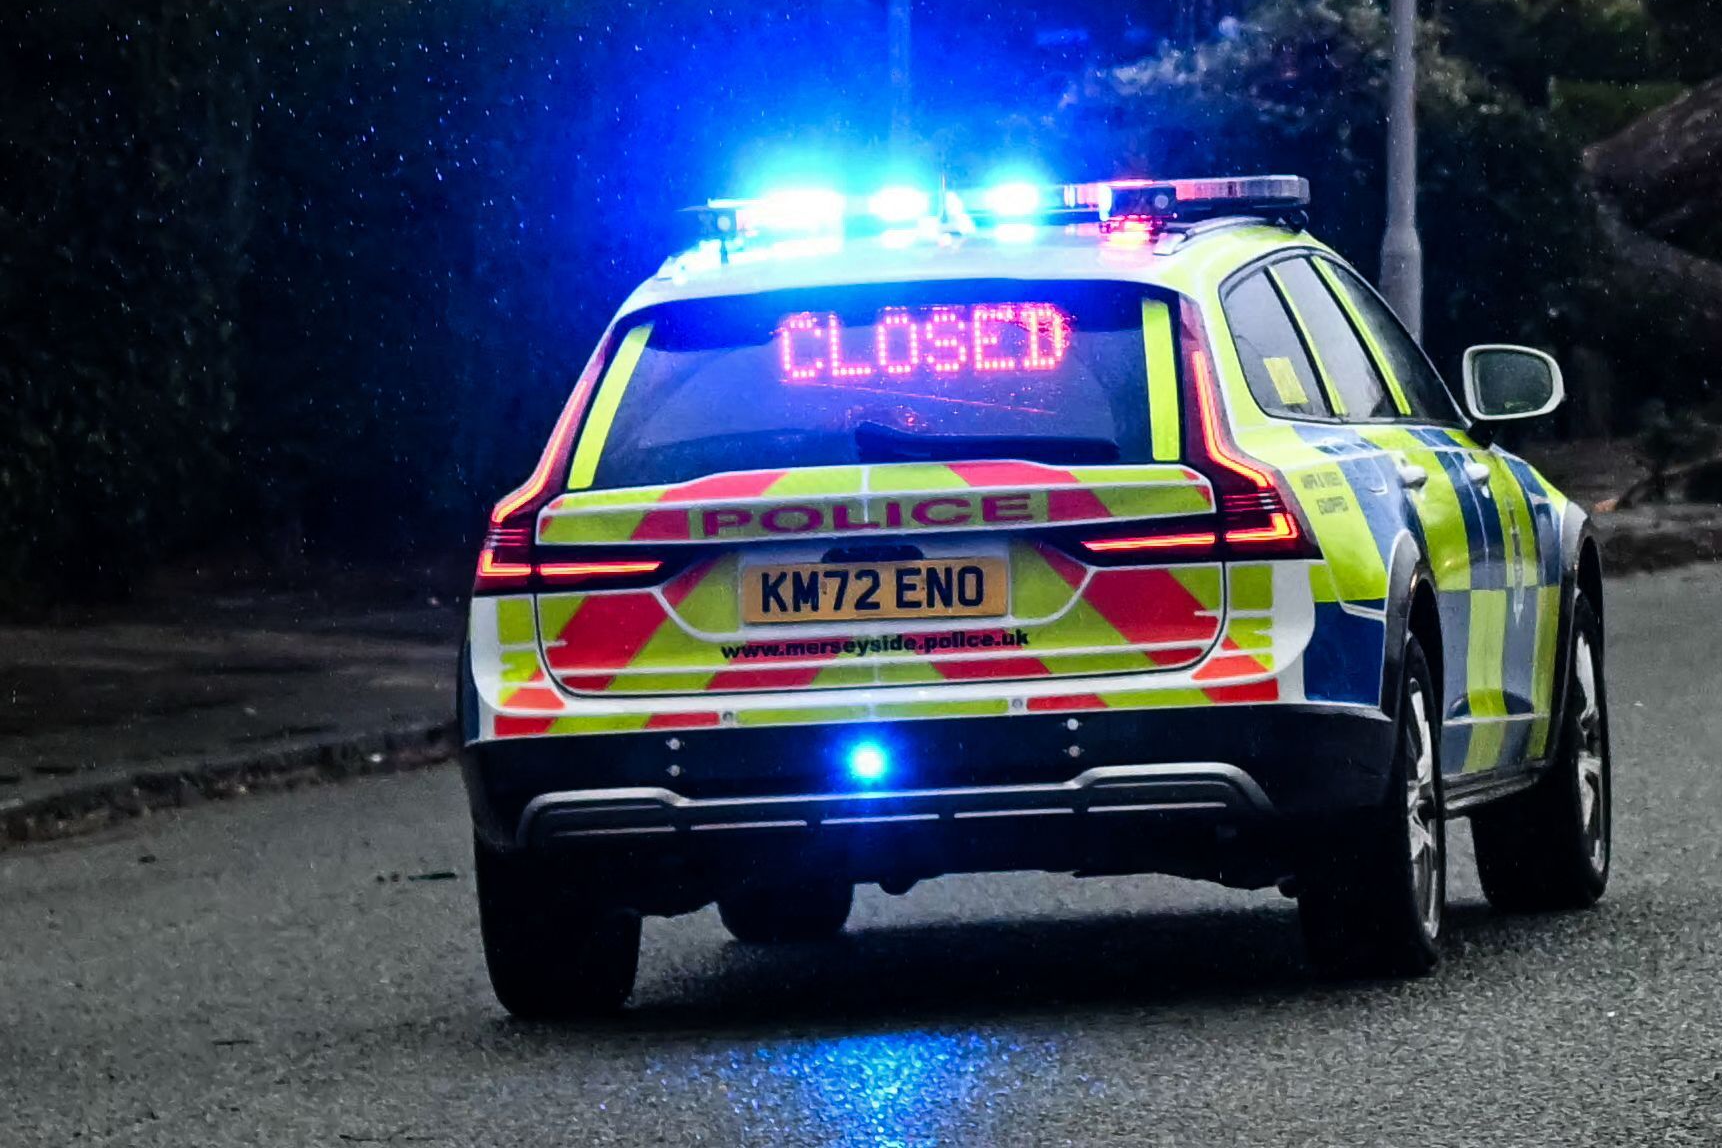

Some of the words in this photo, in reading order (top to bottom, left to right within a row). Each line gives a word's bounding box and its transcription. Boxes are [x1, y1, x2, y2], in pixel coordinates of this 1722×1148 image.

[778, 306, 1071, 380] CLOSED
[702, 493, 1034, 537] POLICE
[760, 569, 882, 613] KM72
[895, 565, 985, 609] ENO
[720, 628, 1029, 660] www.merseyside.police.uk
